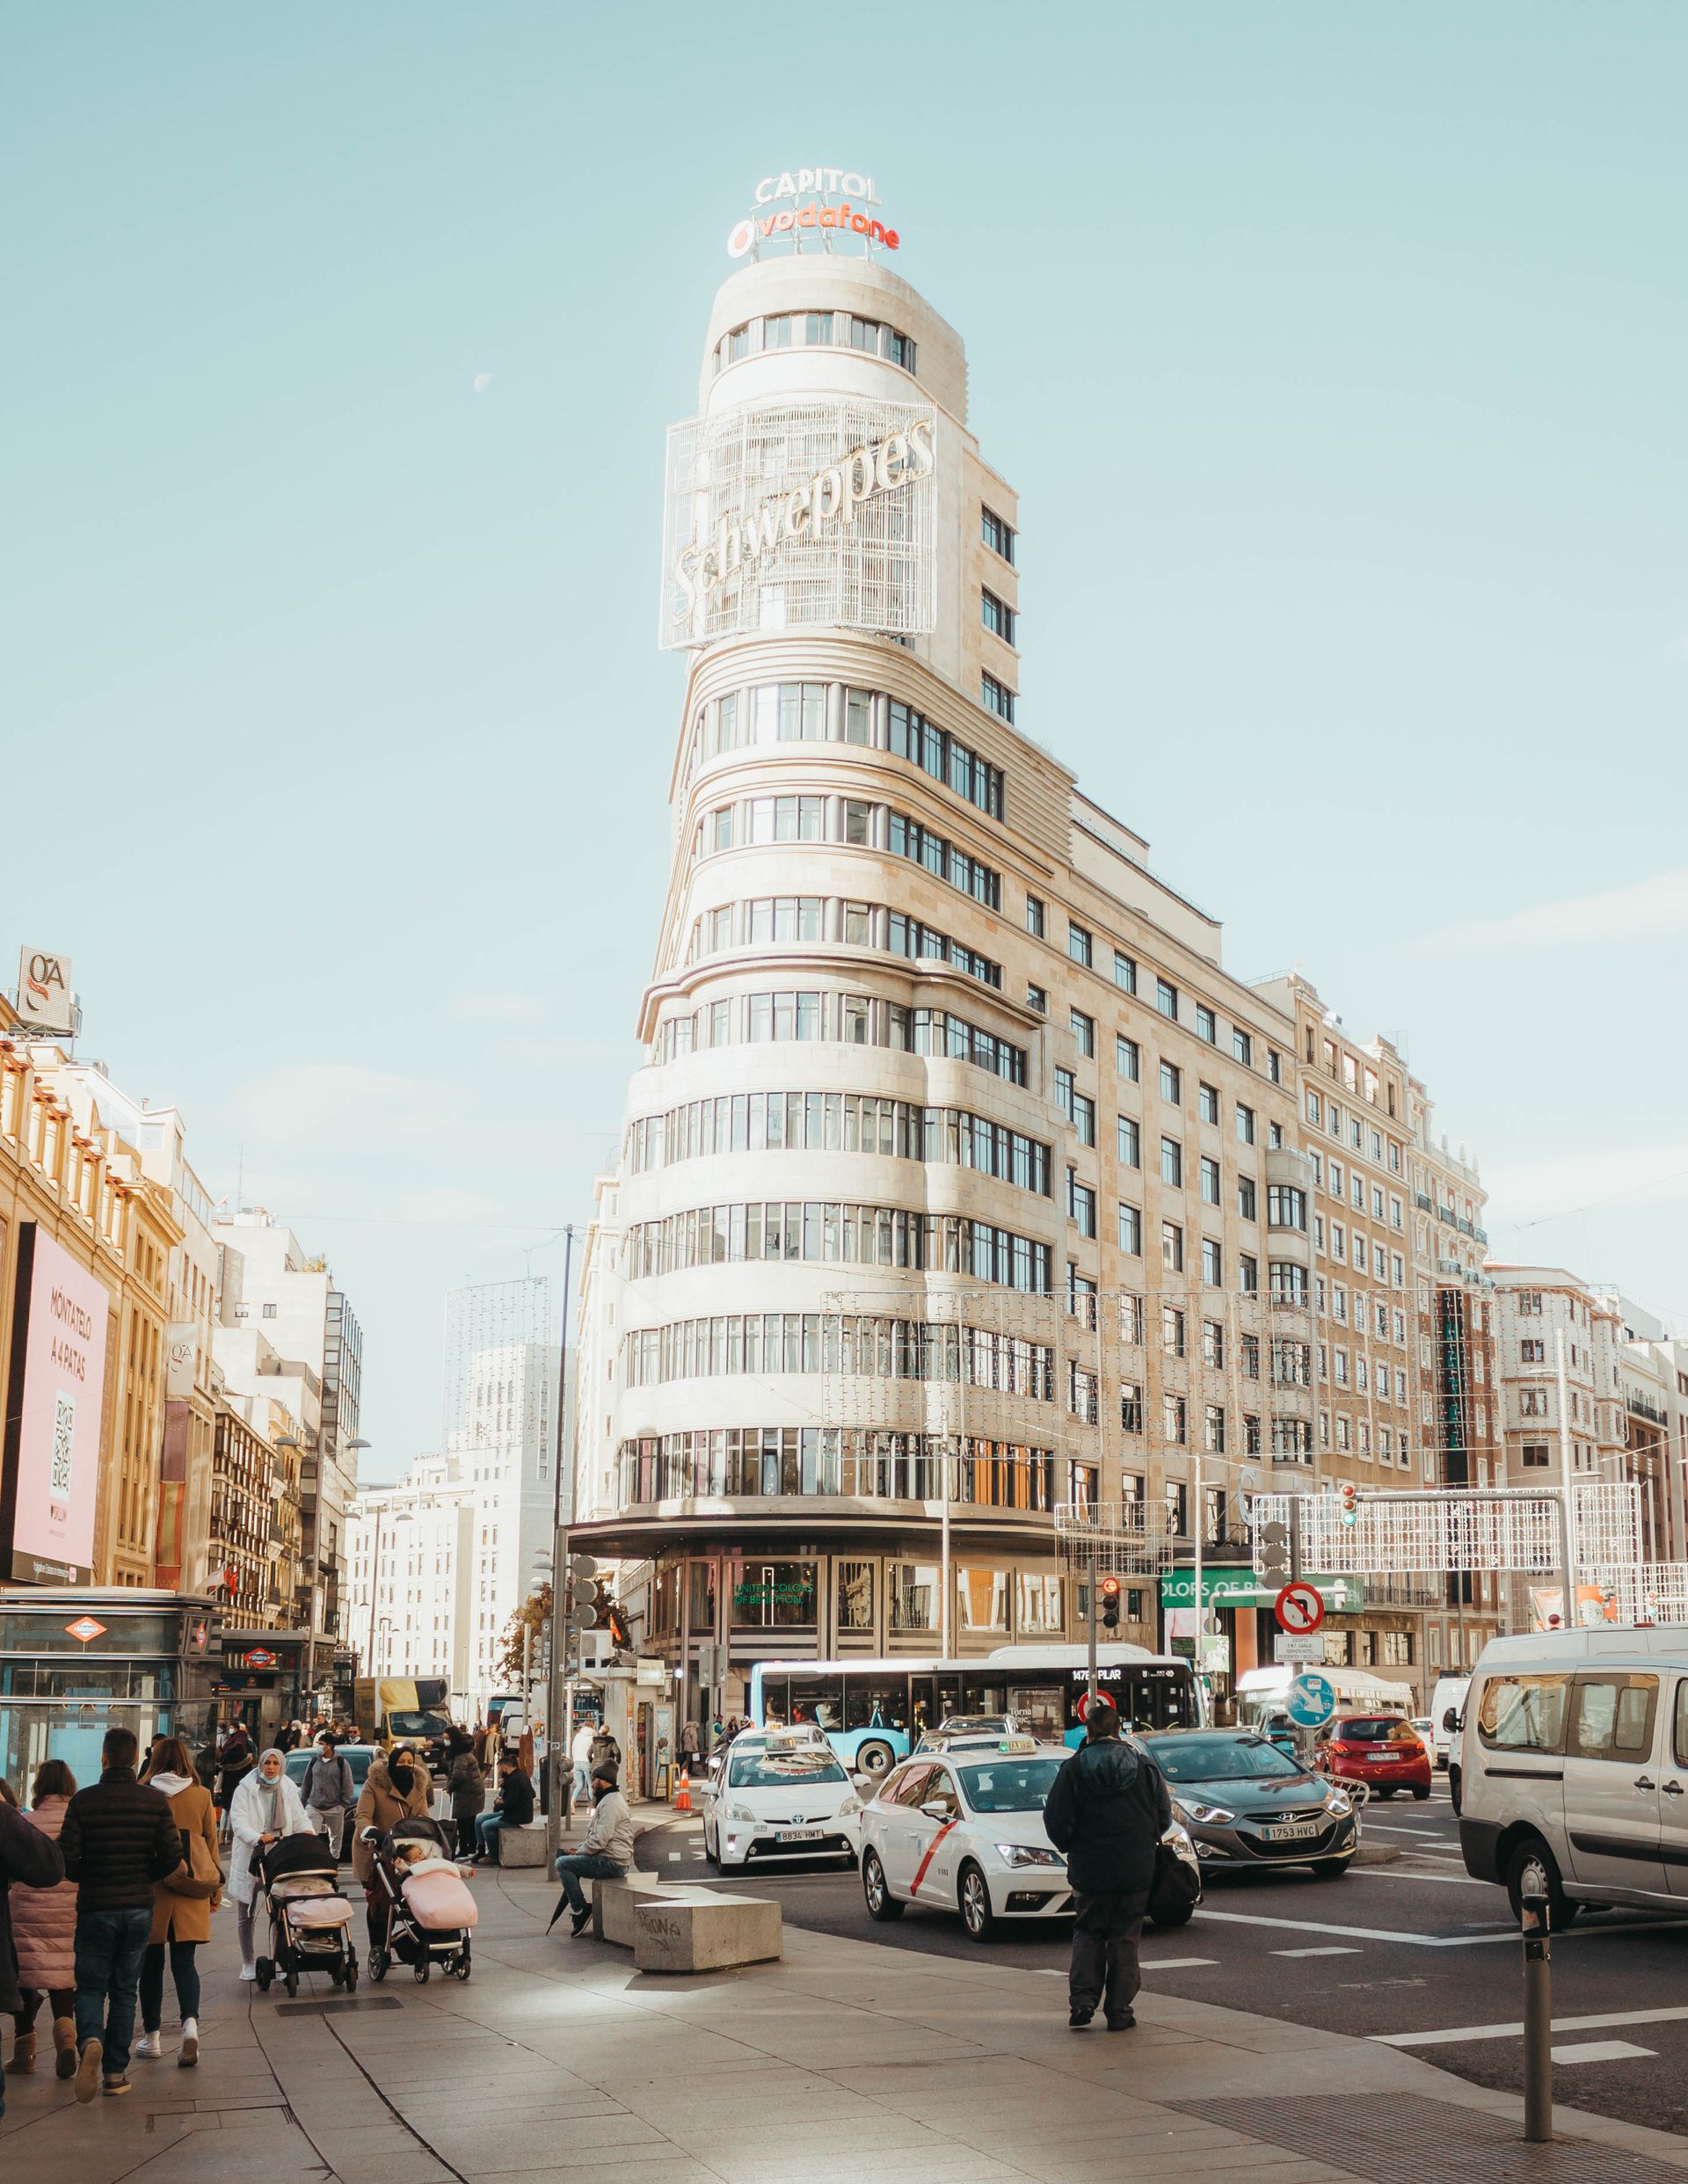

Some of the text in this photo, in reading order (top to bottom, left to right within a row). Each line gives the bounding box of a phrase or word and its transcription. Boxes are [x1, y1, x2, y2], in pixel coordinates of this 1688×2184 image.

[754, 167, 883, 206] CAPITOL
[759, 201, 900, 251] vodafone
[674, 419, 934, 625] Schweppes
[50, 1335, 86, 1382] A 4 PATAS
[735, 1583, 814, 1593] UNITED COLORS
[733, 1594, 748, 1605] OF
[1097, 1670, 1122, 1680] PILAR
[782, 1830, 820, 1840] 8834 HMT
[1272, 1826, 1314, 1838] 1753 HVC
